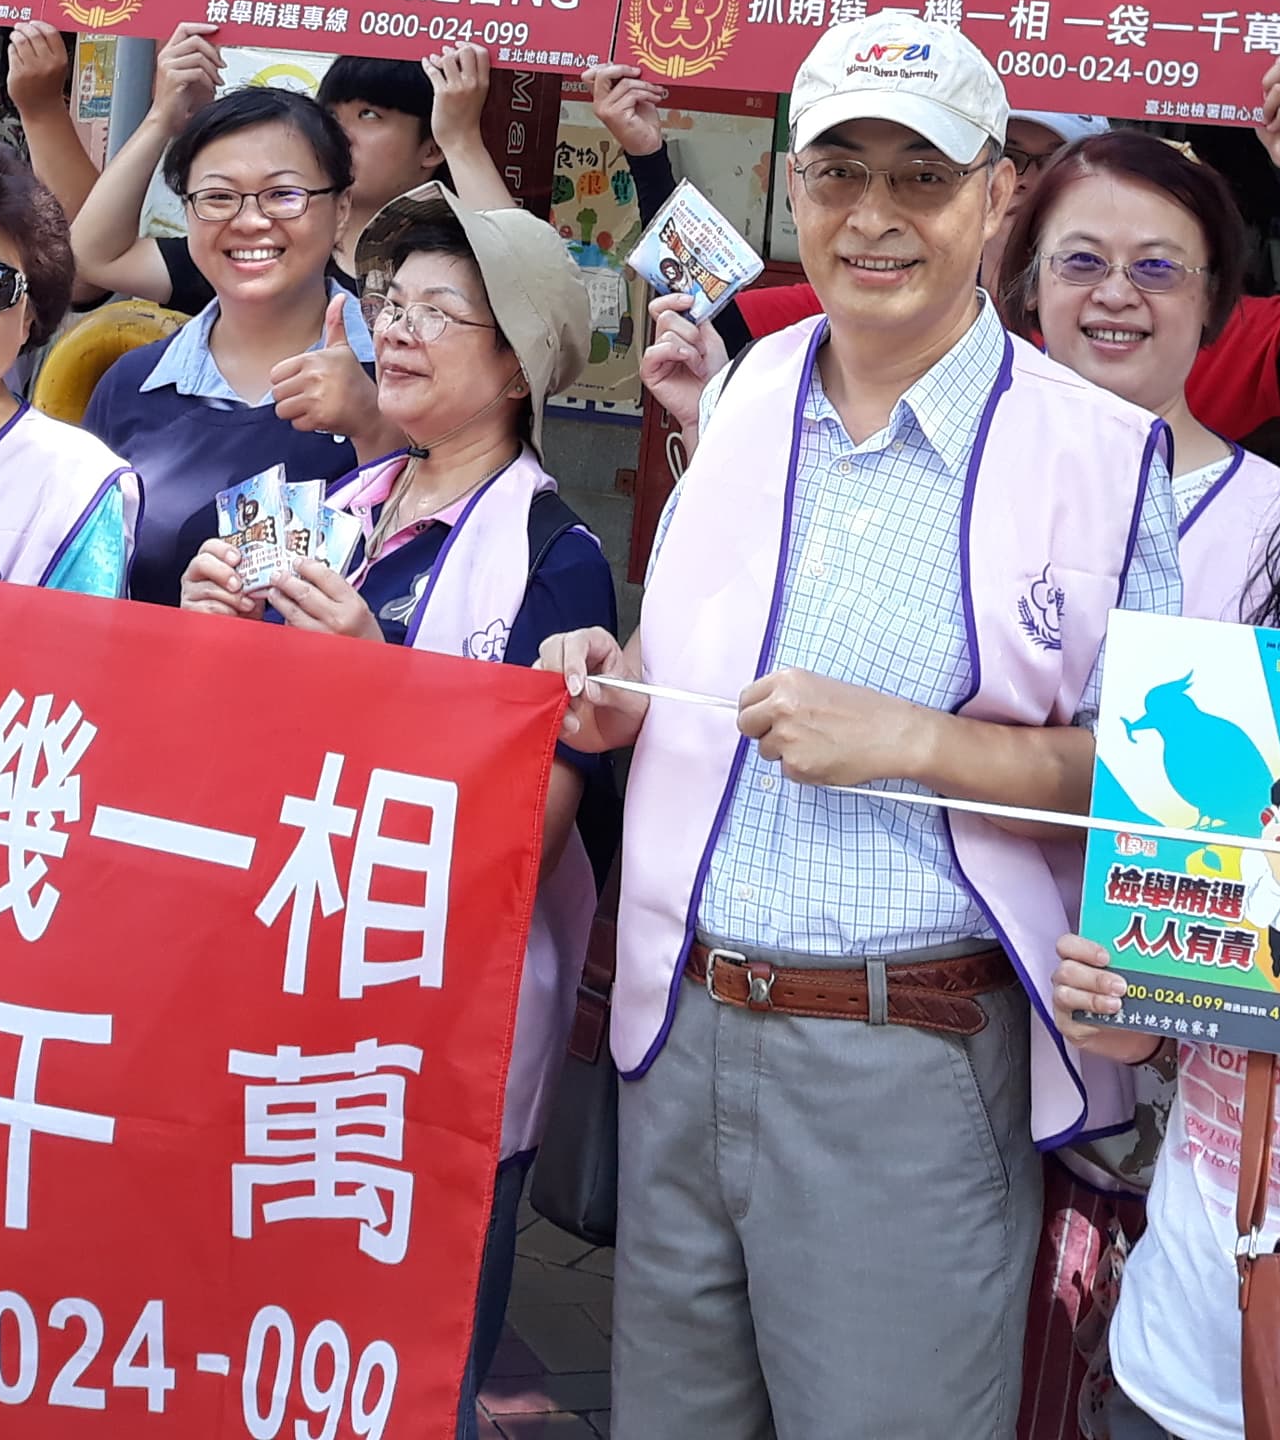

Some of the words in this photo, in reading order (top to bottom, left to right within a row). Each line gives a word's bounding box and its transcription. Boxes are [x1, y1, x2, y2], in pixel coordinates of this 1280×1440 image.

[360, 11, 529, 46] 0800-024-099
[899, 69, 939, 82] University
[998, 51, 1200, 88] 0800-024-099
[1107, 865, 1245, 920] 檢舉賄選
[1116, 918, 1256, 970] 人人有責
[1124, 983, 1223, 1010] 00-024-099
[1269, 1006, 1280, 1020] 4
